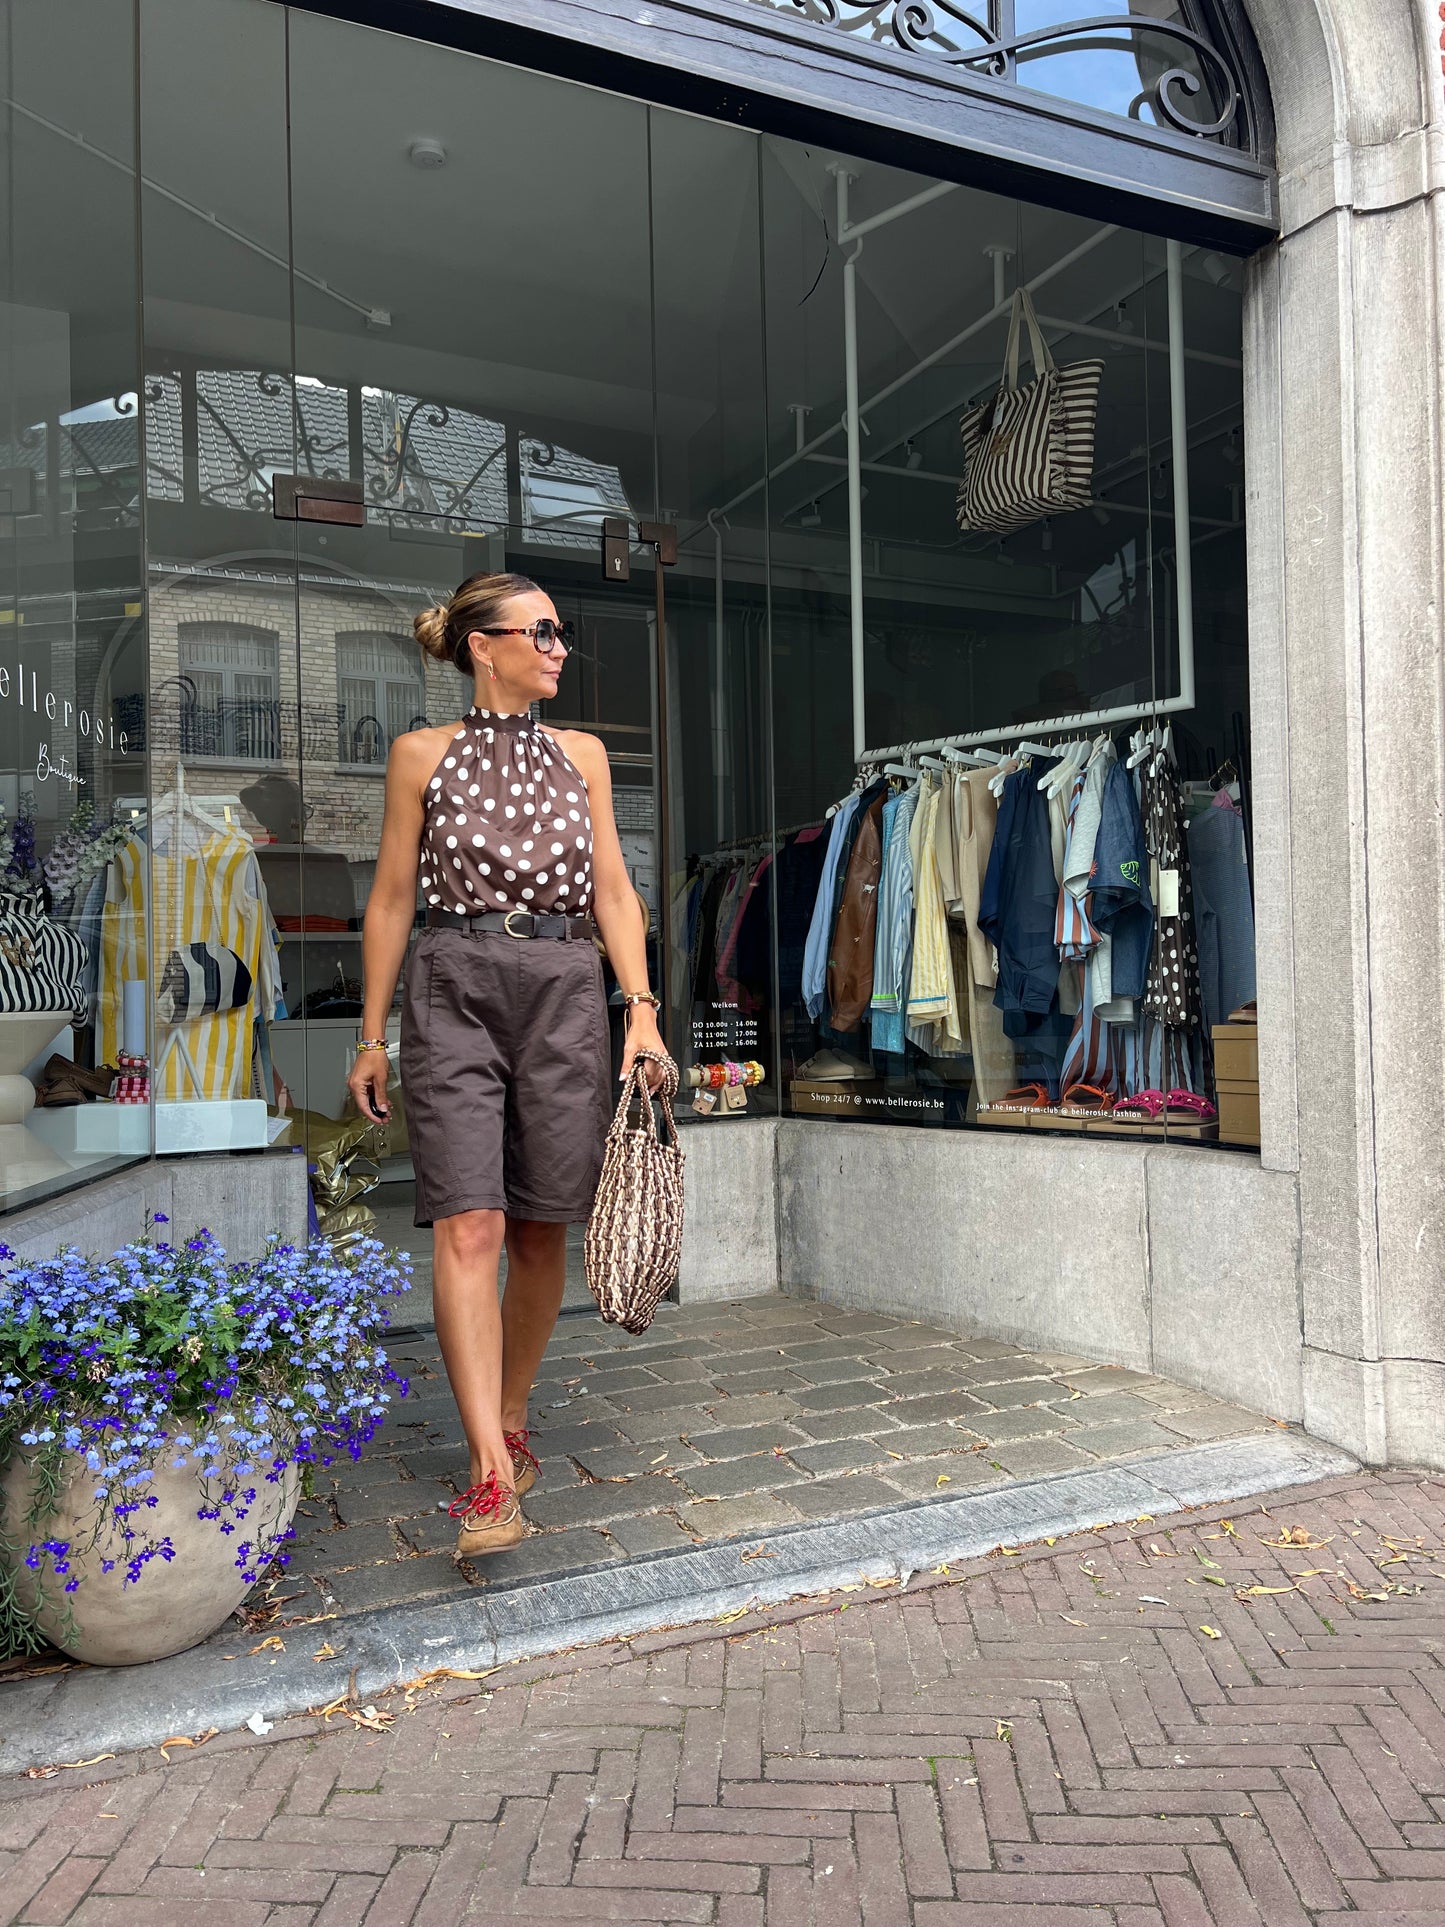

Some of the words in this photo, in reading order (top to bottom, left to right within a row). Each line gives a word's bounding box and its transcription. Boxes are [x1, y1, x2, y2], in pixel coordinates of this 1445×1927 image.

[0, 663, 129, 755] ellerosie
[36, 742, 87, 791] Boutique
[692, 1021, 704, 1029] DO
[693, 1031, 704, 1039] VR
[693, 1041, 704, 1049] ZA
[735, 1039, 758, 1047] 16.00u
[810, 1092, 831, 1104] Shop
[833, 1094, 851, 1104] 24/7
[853, 1095, 862, 1105] @
[865, 1096, 945, 1109] www.bellerosie.be
[975, 1102, 990, 1111] Join
[992, 1103, 1005, 1111] the
[1060, 1107, 1069, 1115] @
[1071, 1108, 1142, 1118] bellerosie_fashion
